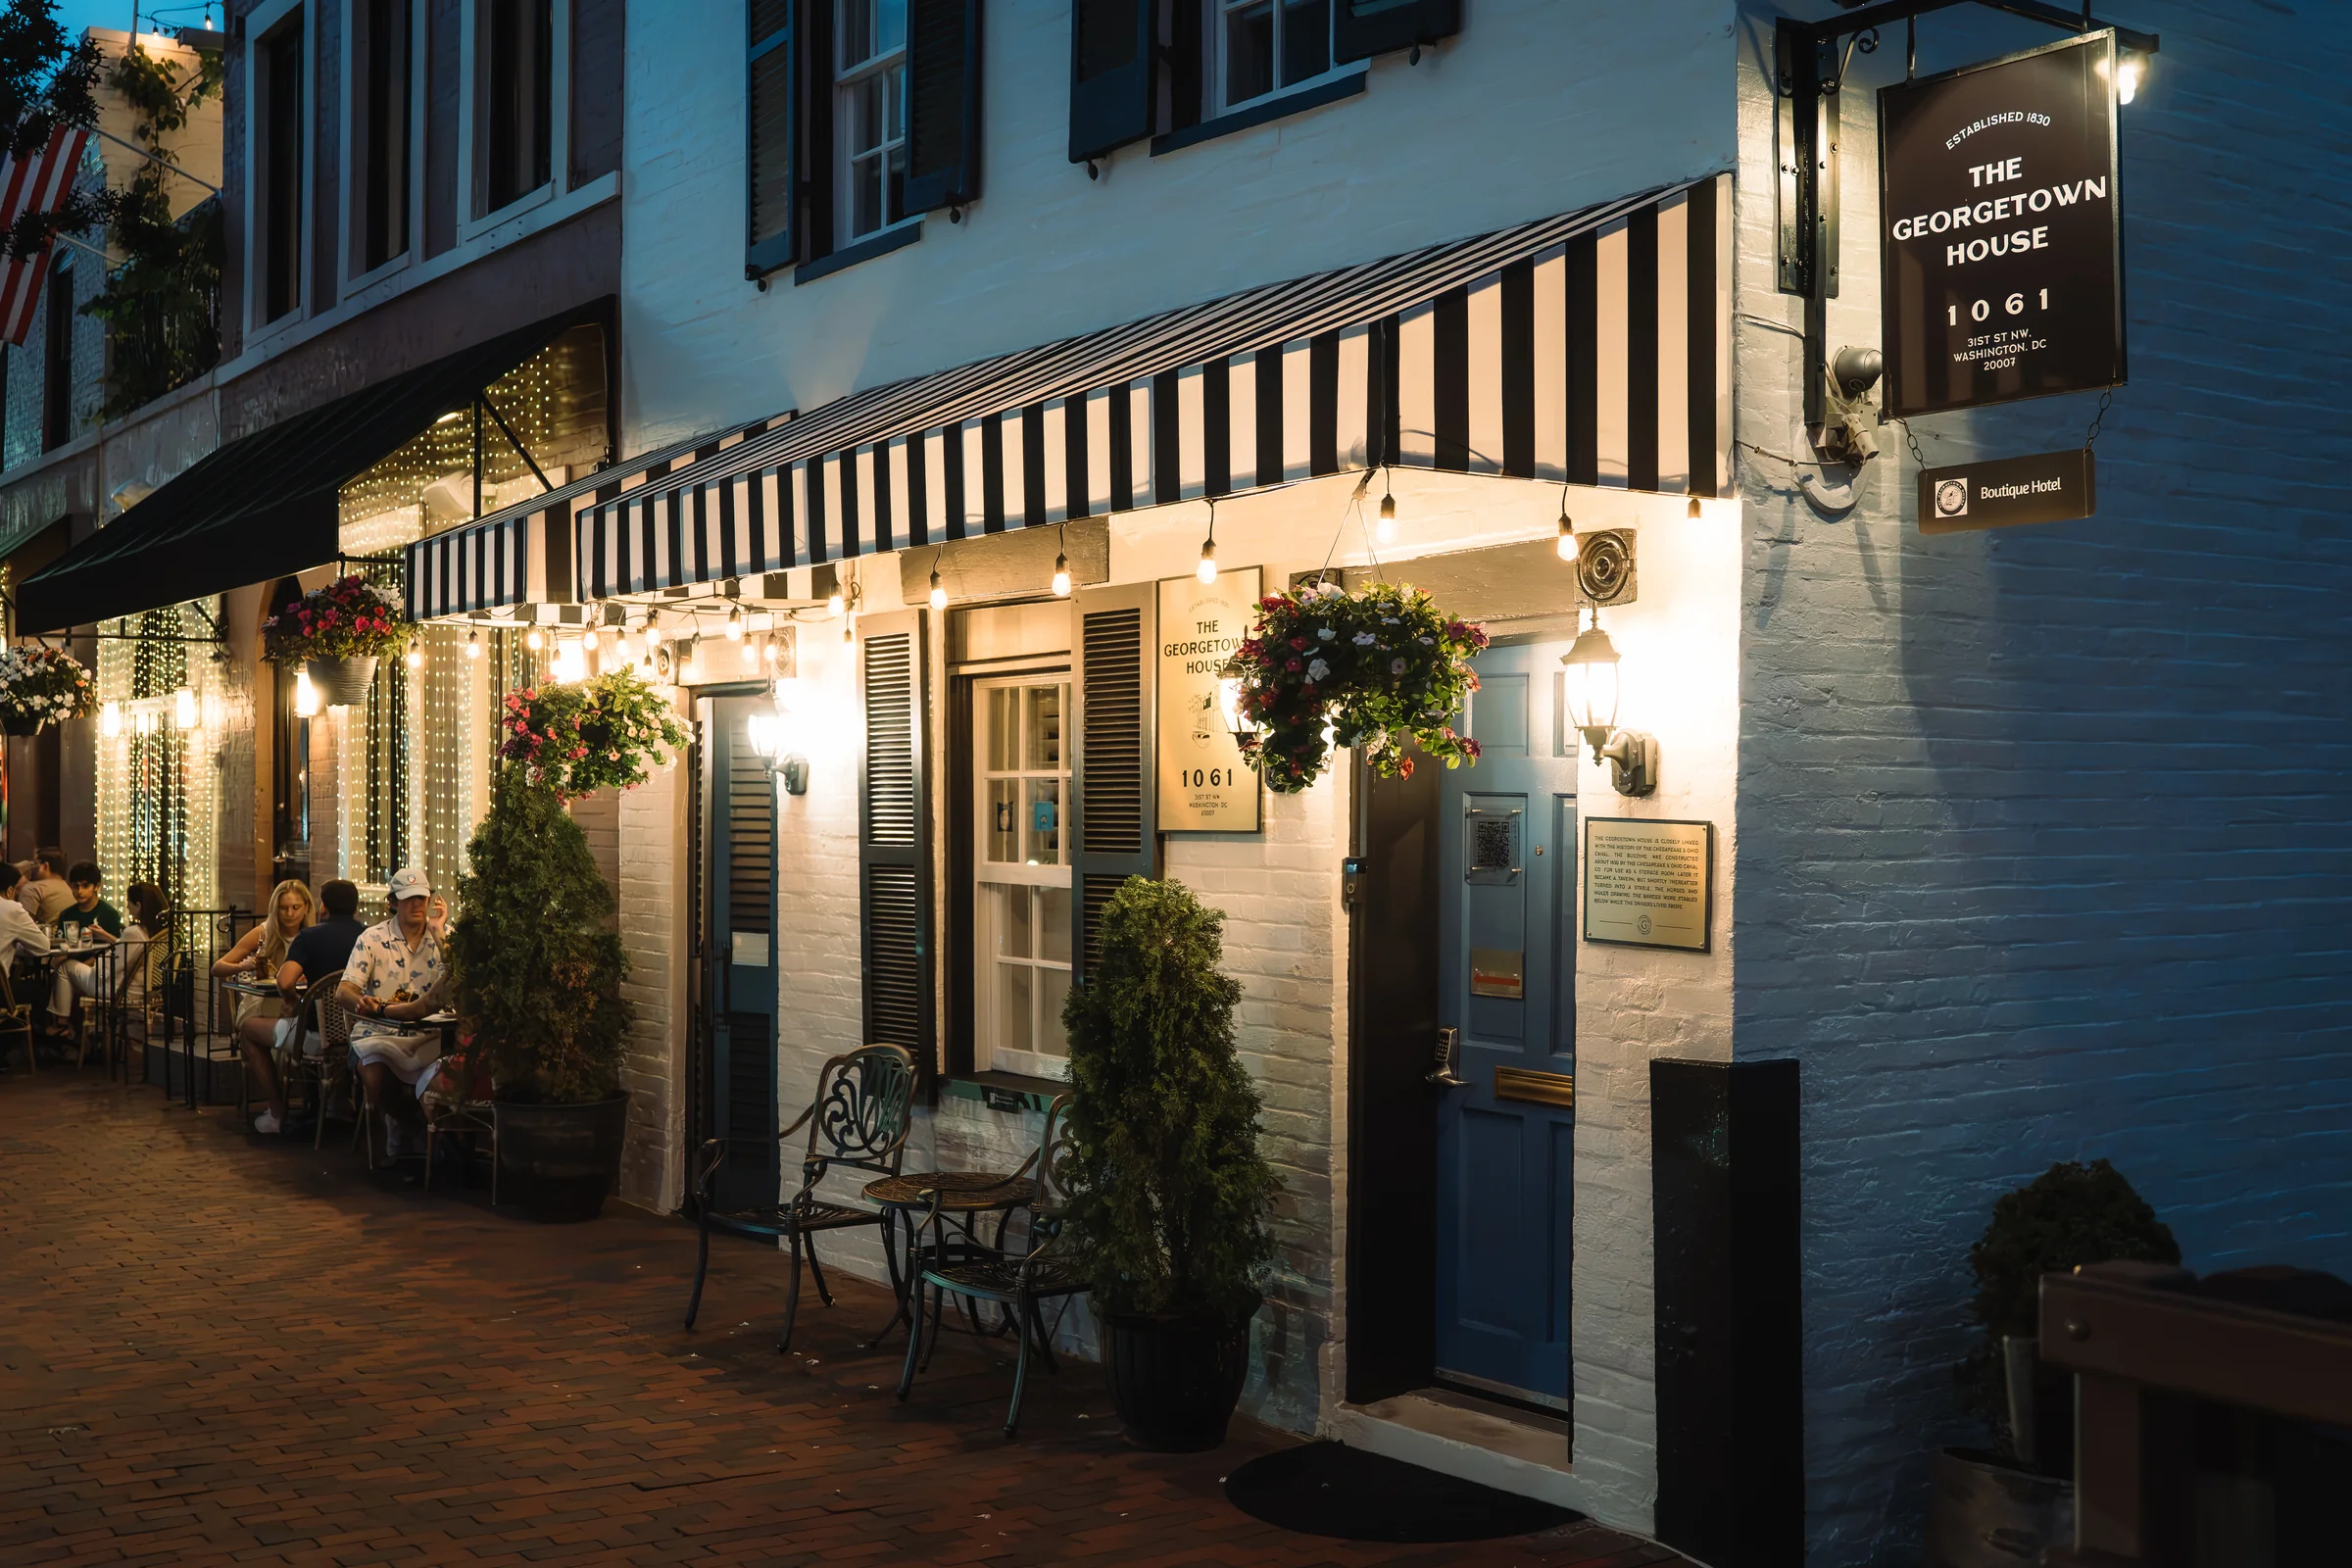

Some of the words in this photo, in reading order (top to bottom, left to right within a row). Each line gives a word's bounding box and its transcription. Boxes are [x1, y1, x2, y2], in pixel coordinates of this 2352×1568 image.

[1945, 112, 2024, 150] ESTABLISHED
[2027, 113, 2050, 126] 1830
[1969, 157, 2022, 187] THE
[1892, 176, 2106, 240] GEORGETOWN
[1947, 226, 2048, 266] HOUSE
[1968, 335, 1990, 347] 31ST
[1993, 332, 2007, 343] ST
[2011, 328, 2032, 340] NW.
[2032, 339, 2047, 350] DC
[1984, 357, 2016, 370] 20007
[1981, 483, 2030, 500] Boutique
[2032, 477, 2062, 493] Hotel
[1197, 619, 1219, 634] THE
[1164, 637, 1247, 657] GEORGETOW
[1182, 768, 1232, 788] 1061
